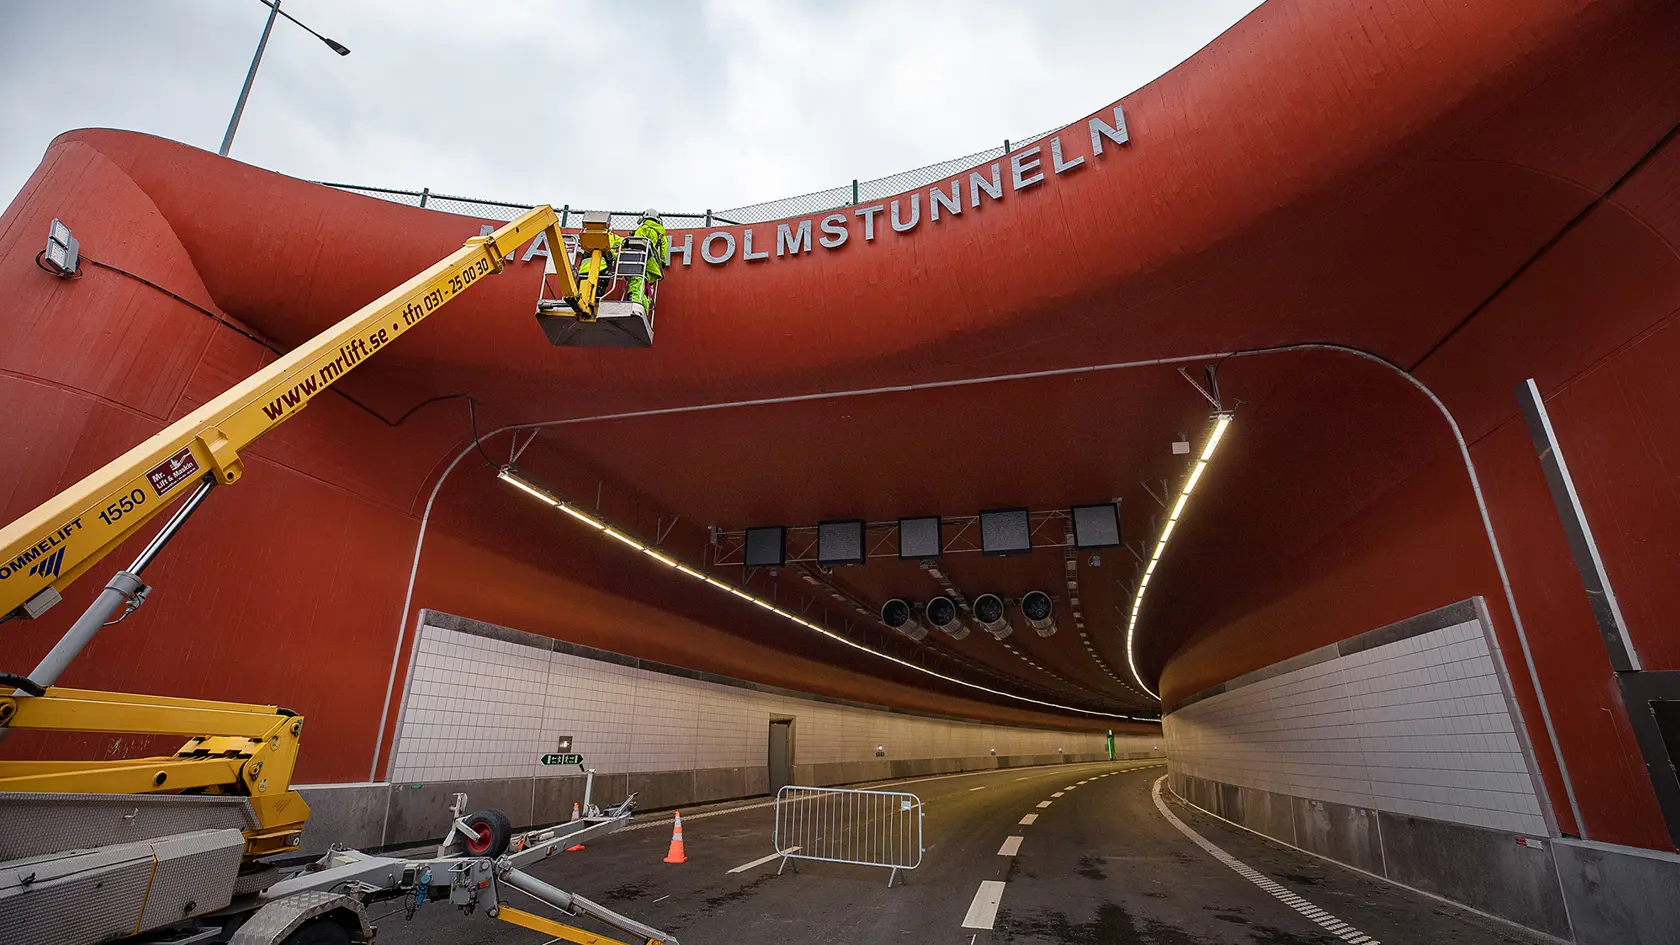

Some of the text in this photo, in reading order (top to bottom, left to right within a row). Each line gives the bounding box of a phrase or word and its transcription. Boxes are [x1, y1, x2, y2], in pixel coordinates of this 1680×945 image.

[479, 105, 1129, 267] AHOLMSTUNNELN
[262, 327, 389, 421] www.mrlift.se
[402, 303, 424, 326] tfn
[424, 288, 444, 312] 031
[448, 276, 463, 295] 25
[463, 266, 476, 285] 00
[476, 257, 489, 276] 30
[152, 472, 166, 483] Mr.
[172, 462, 194, 478] Maskin
[98, 488, 146, 526] 1550
[0, 517, 84, 580] OMMELIFT
